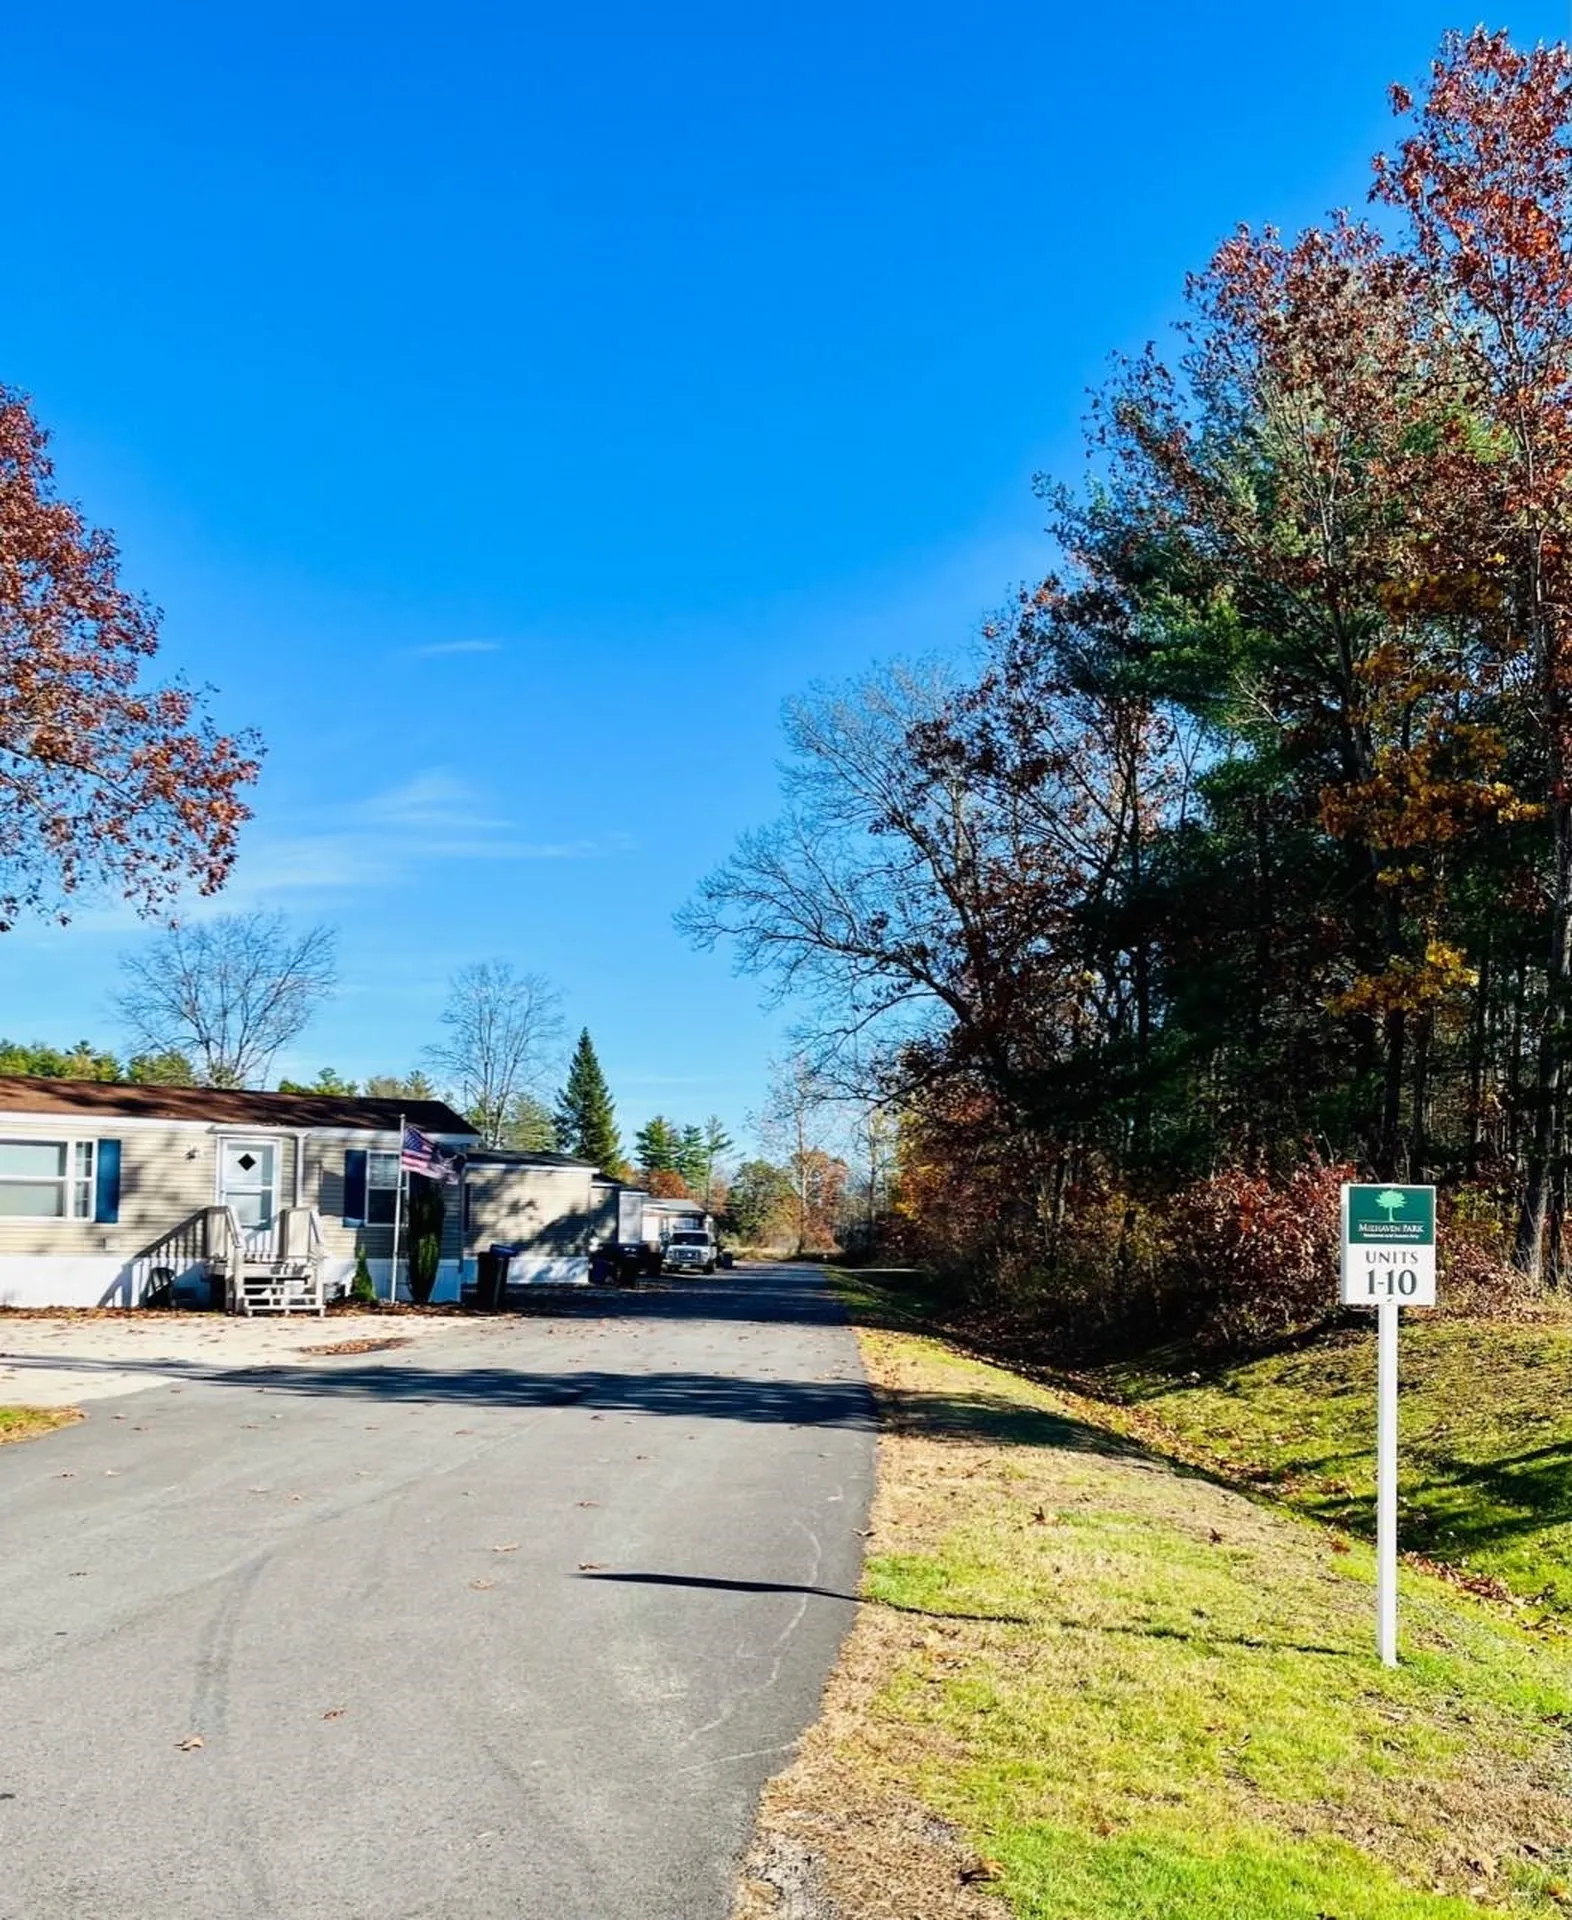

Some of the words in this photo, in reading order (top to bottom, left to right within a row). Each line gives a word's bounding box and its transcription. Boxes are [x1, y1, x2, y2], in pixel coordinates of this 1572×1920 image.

[1403, 1224, 1424, 1233] PARK
[1365, 1251, 1418, 1264] UNITS
[1367, 1269, 1417, 1295] 1-10
